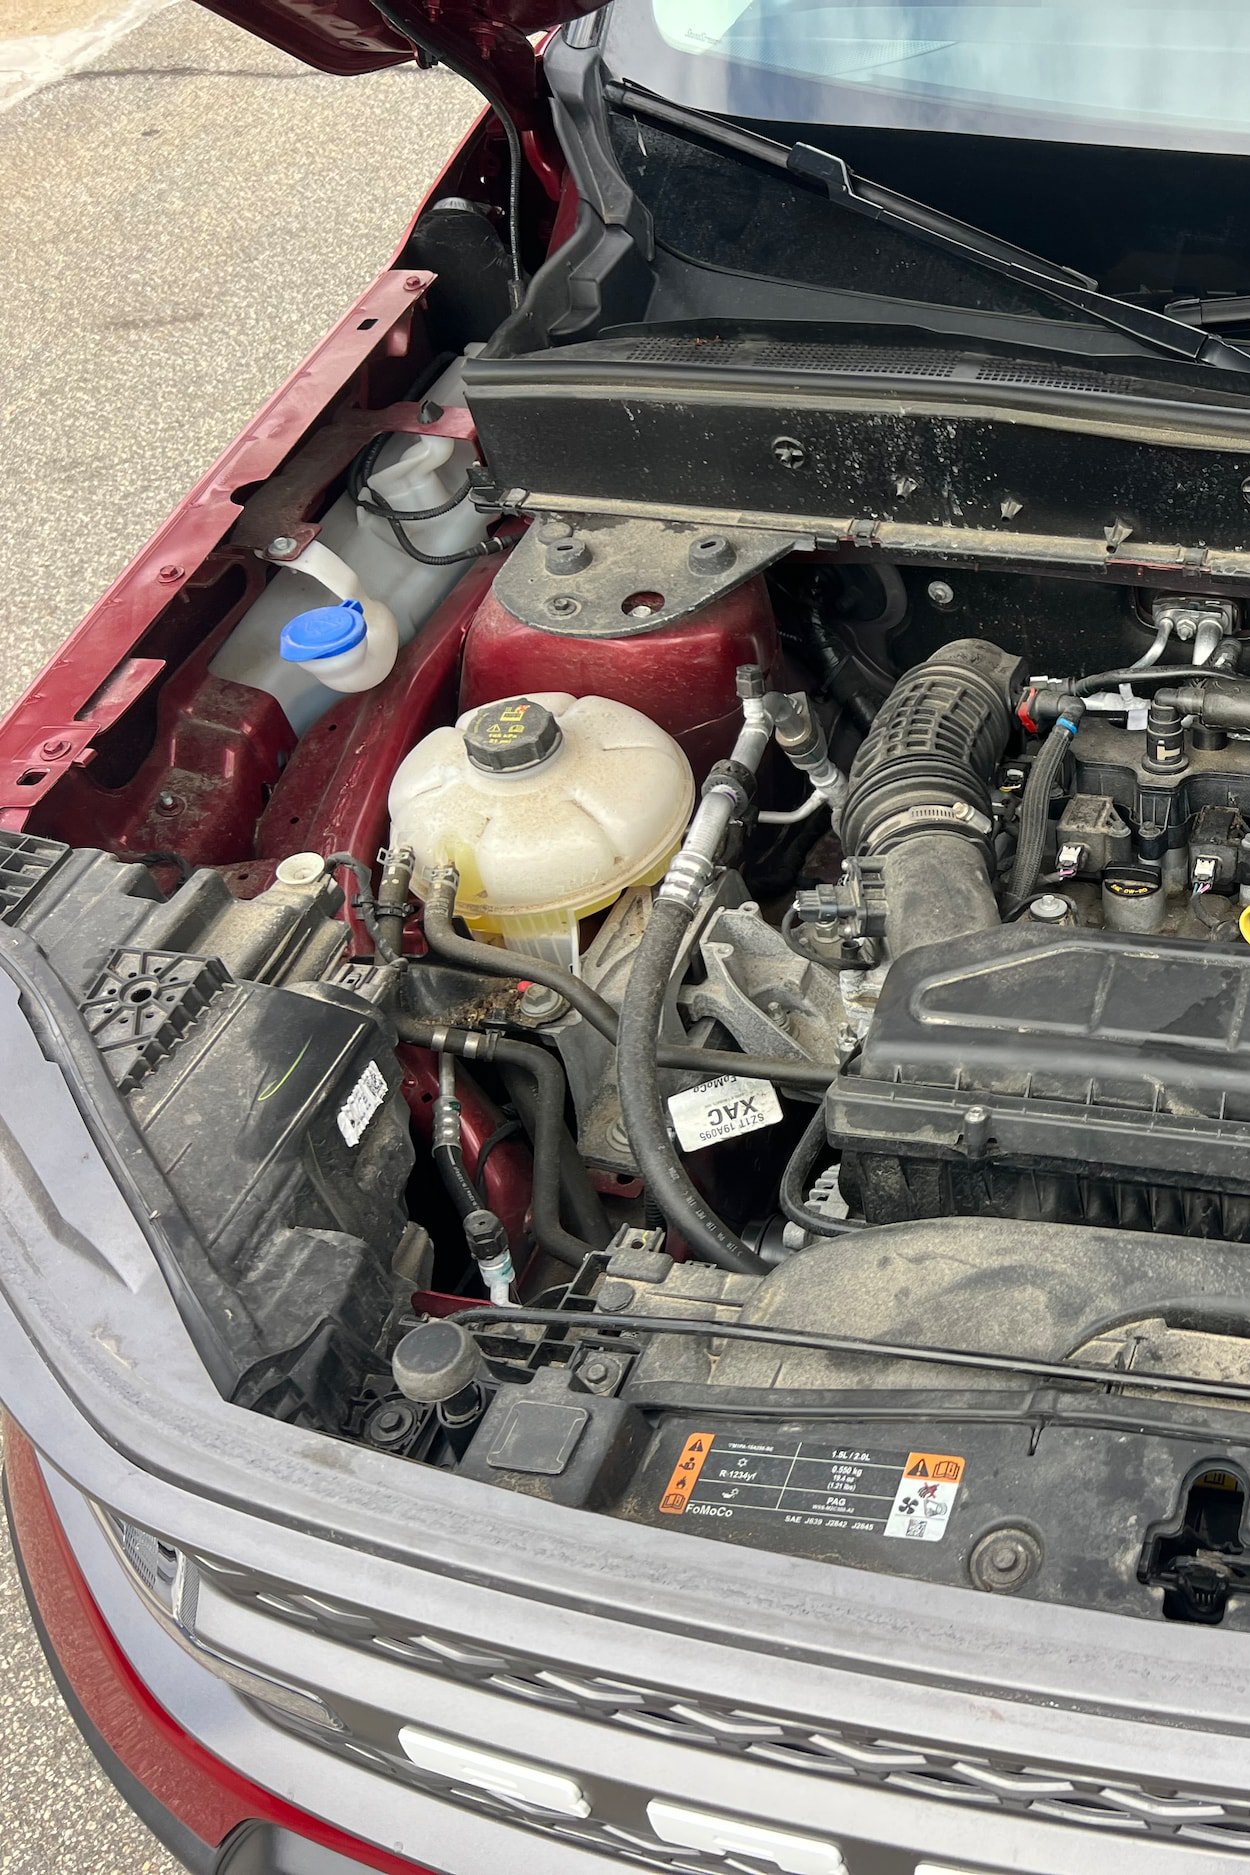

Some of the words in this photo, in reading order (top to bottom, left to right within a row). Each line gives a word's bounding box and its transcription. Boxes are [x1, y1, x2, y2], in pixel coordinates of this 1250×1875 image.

[707, 1095, 759, 1126] XAC
[738, 1112, 765, 1129] SZ1T
[699, 1123, 736, 1142] 19A095
[853, 1452, 871, 1461] 2.0L
[719, 1469, 758, 1481] R-1234yf
[852, 1467, 863, 1477] kg
[826, 1497, 846, 1506] PAG
[685, 1503, 733, 1518] FoMoCo
[784, 1515, 802, 1523] SAE
